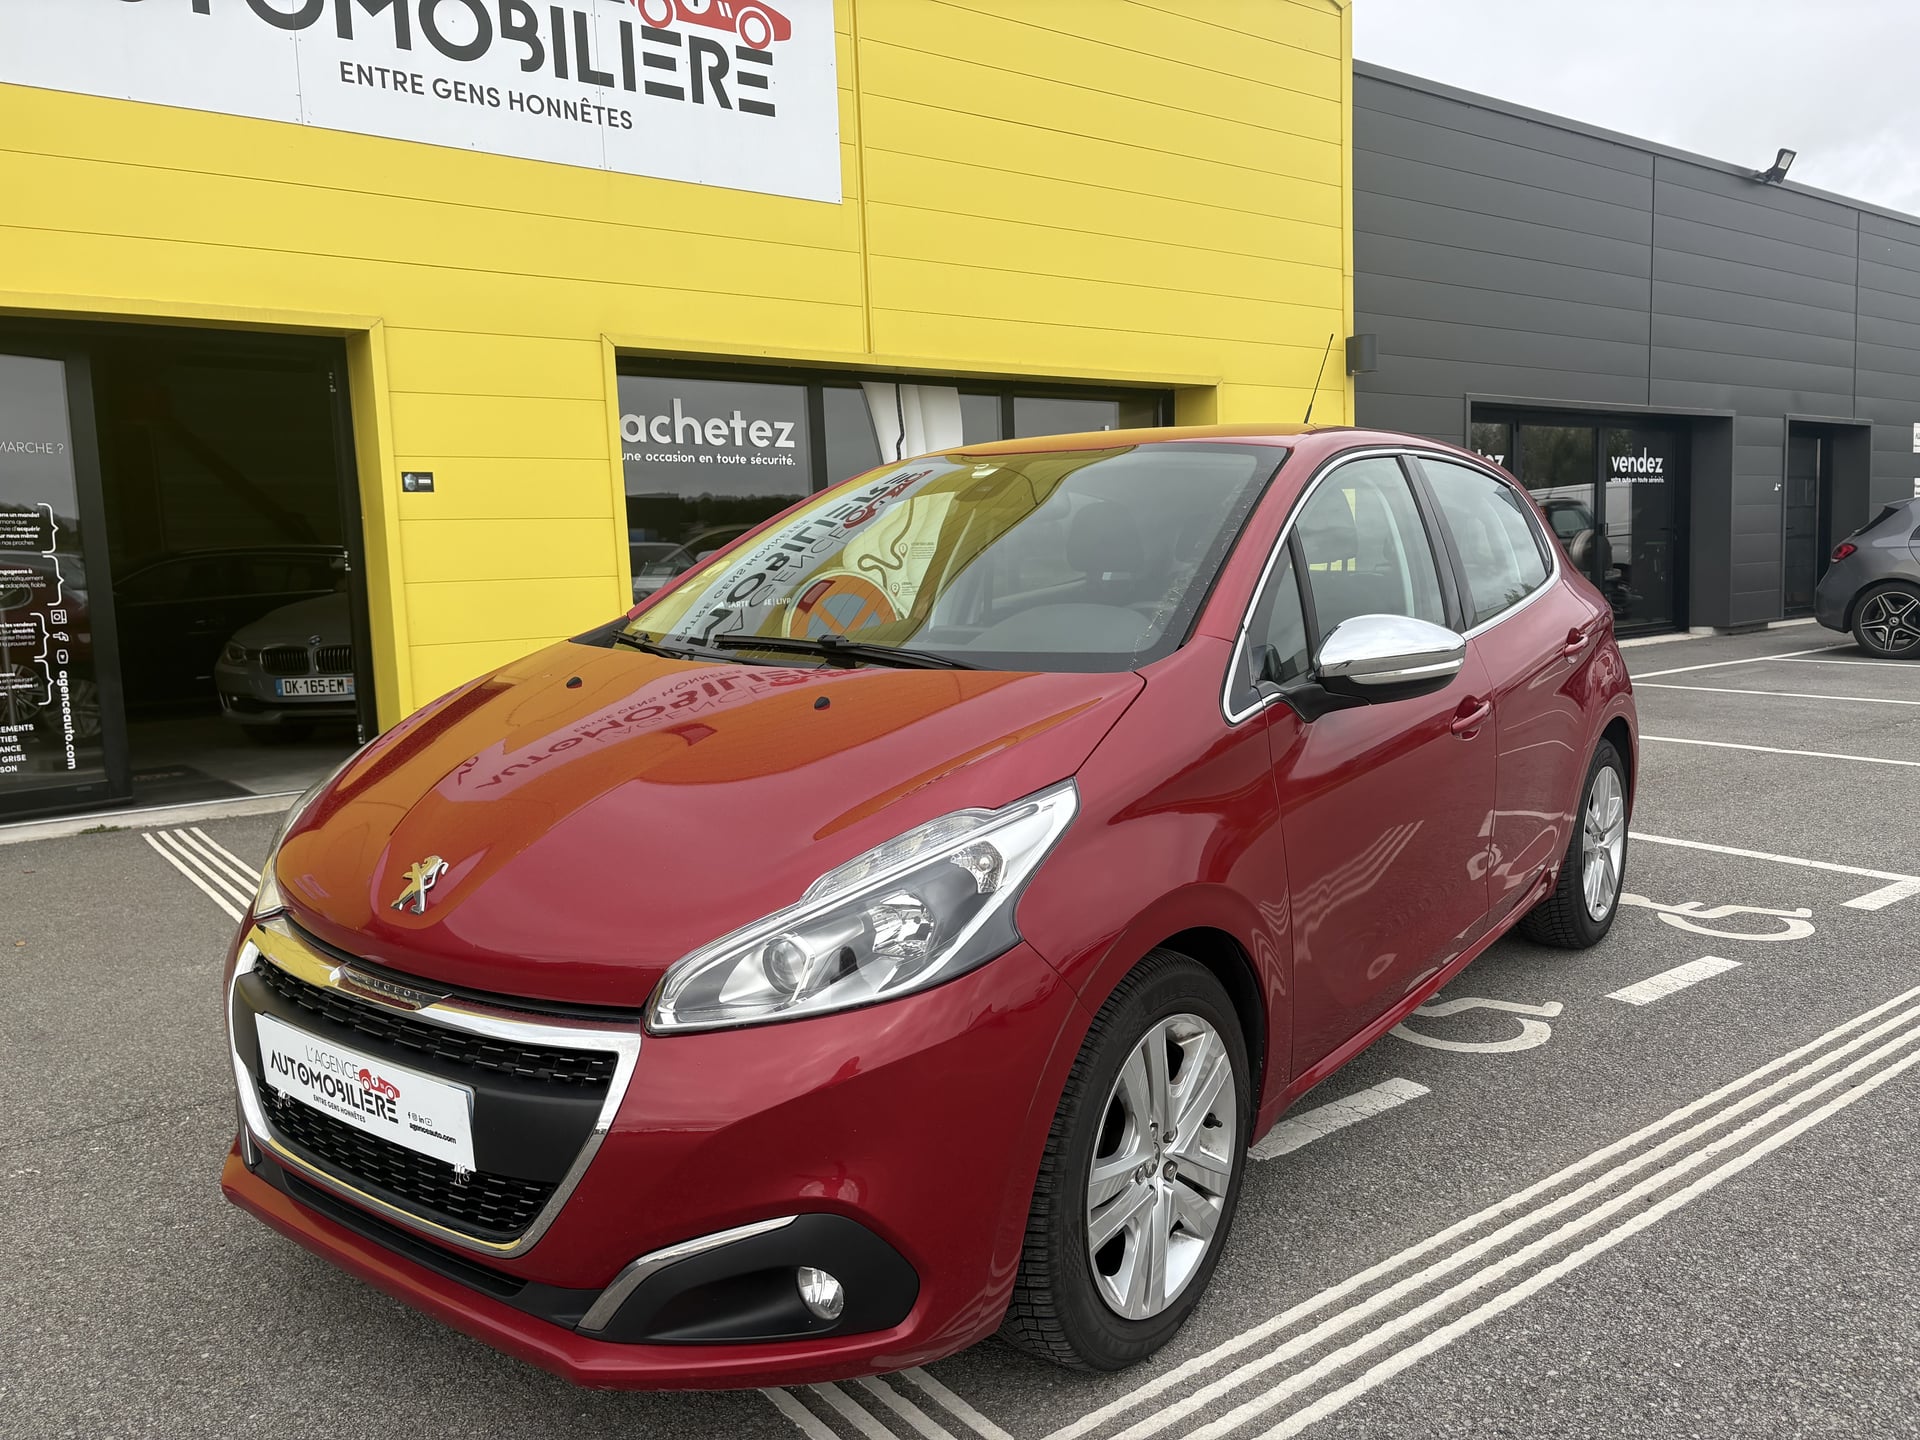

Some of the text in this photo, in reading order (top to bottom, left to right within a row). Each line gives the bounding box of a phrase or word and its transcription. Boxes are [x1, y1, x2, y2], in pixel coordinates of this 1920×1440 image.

[120, 0, 776, 117] MOBILIERE
[340, 61, 633, 130] ENTRE GENS HONNÊTES
[620, 398, 795, 448] achetez
[645, 451, 695, 463] occasion
[699, 455, 713, 463] en
[717, 453, 747, 464] toute
[751, 453, 796, 466] sécurité.
[1611, 447, 1664, 473] vendez
[284, 678, 345, 694] DK-165-EM
[56, 670, 76, 770] agenceauto.com
[1, 753, 27, 763] GRISE
[305, 1044, 360, 1082] L'AGENCE
[271, 1049, 399, 1124] AUTOMOBILIERE
